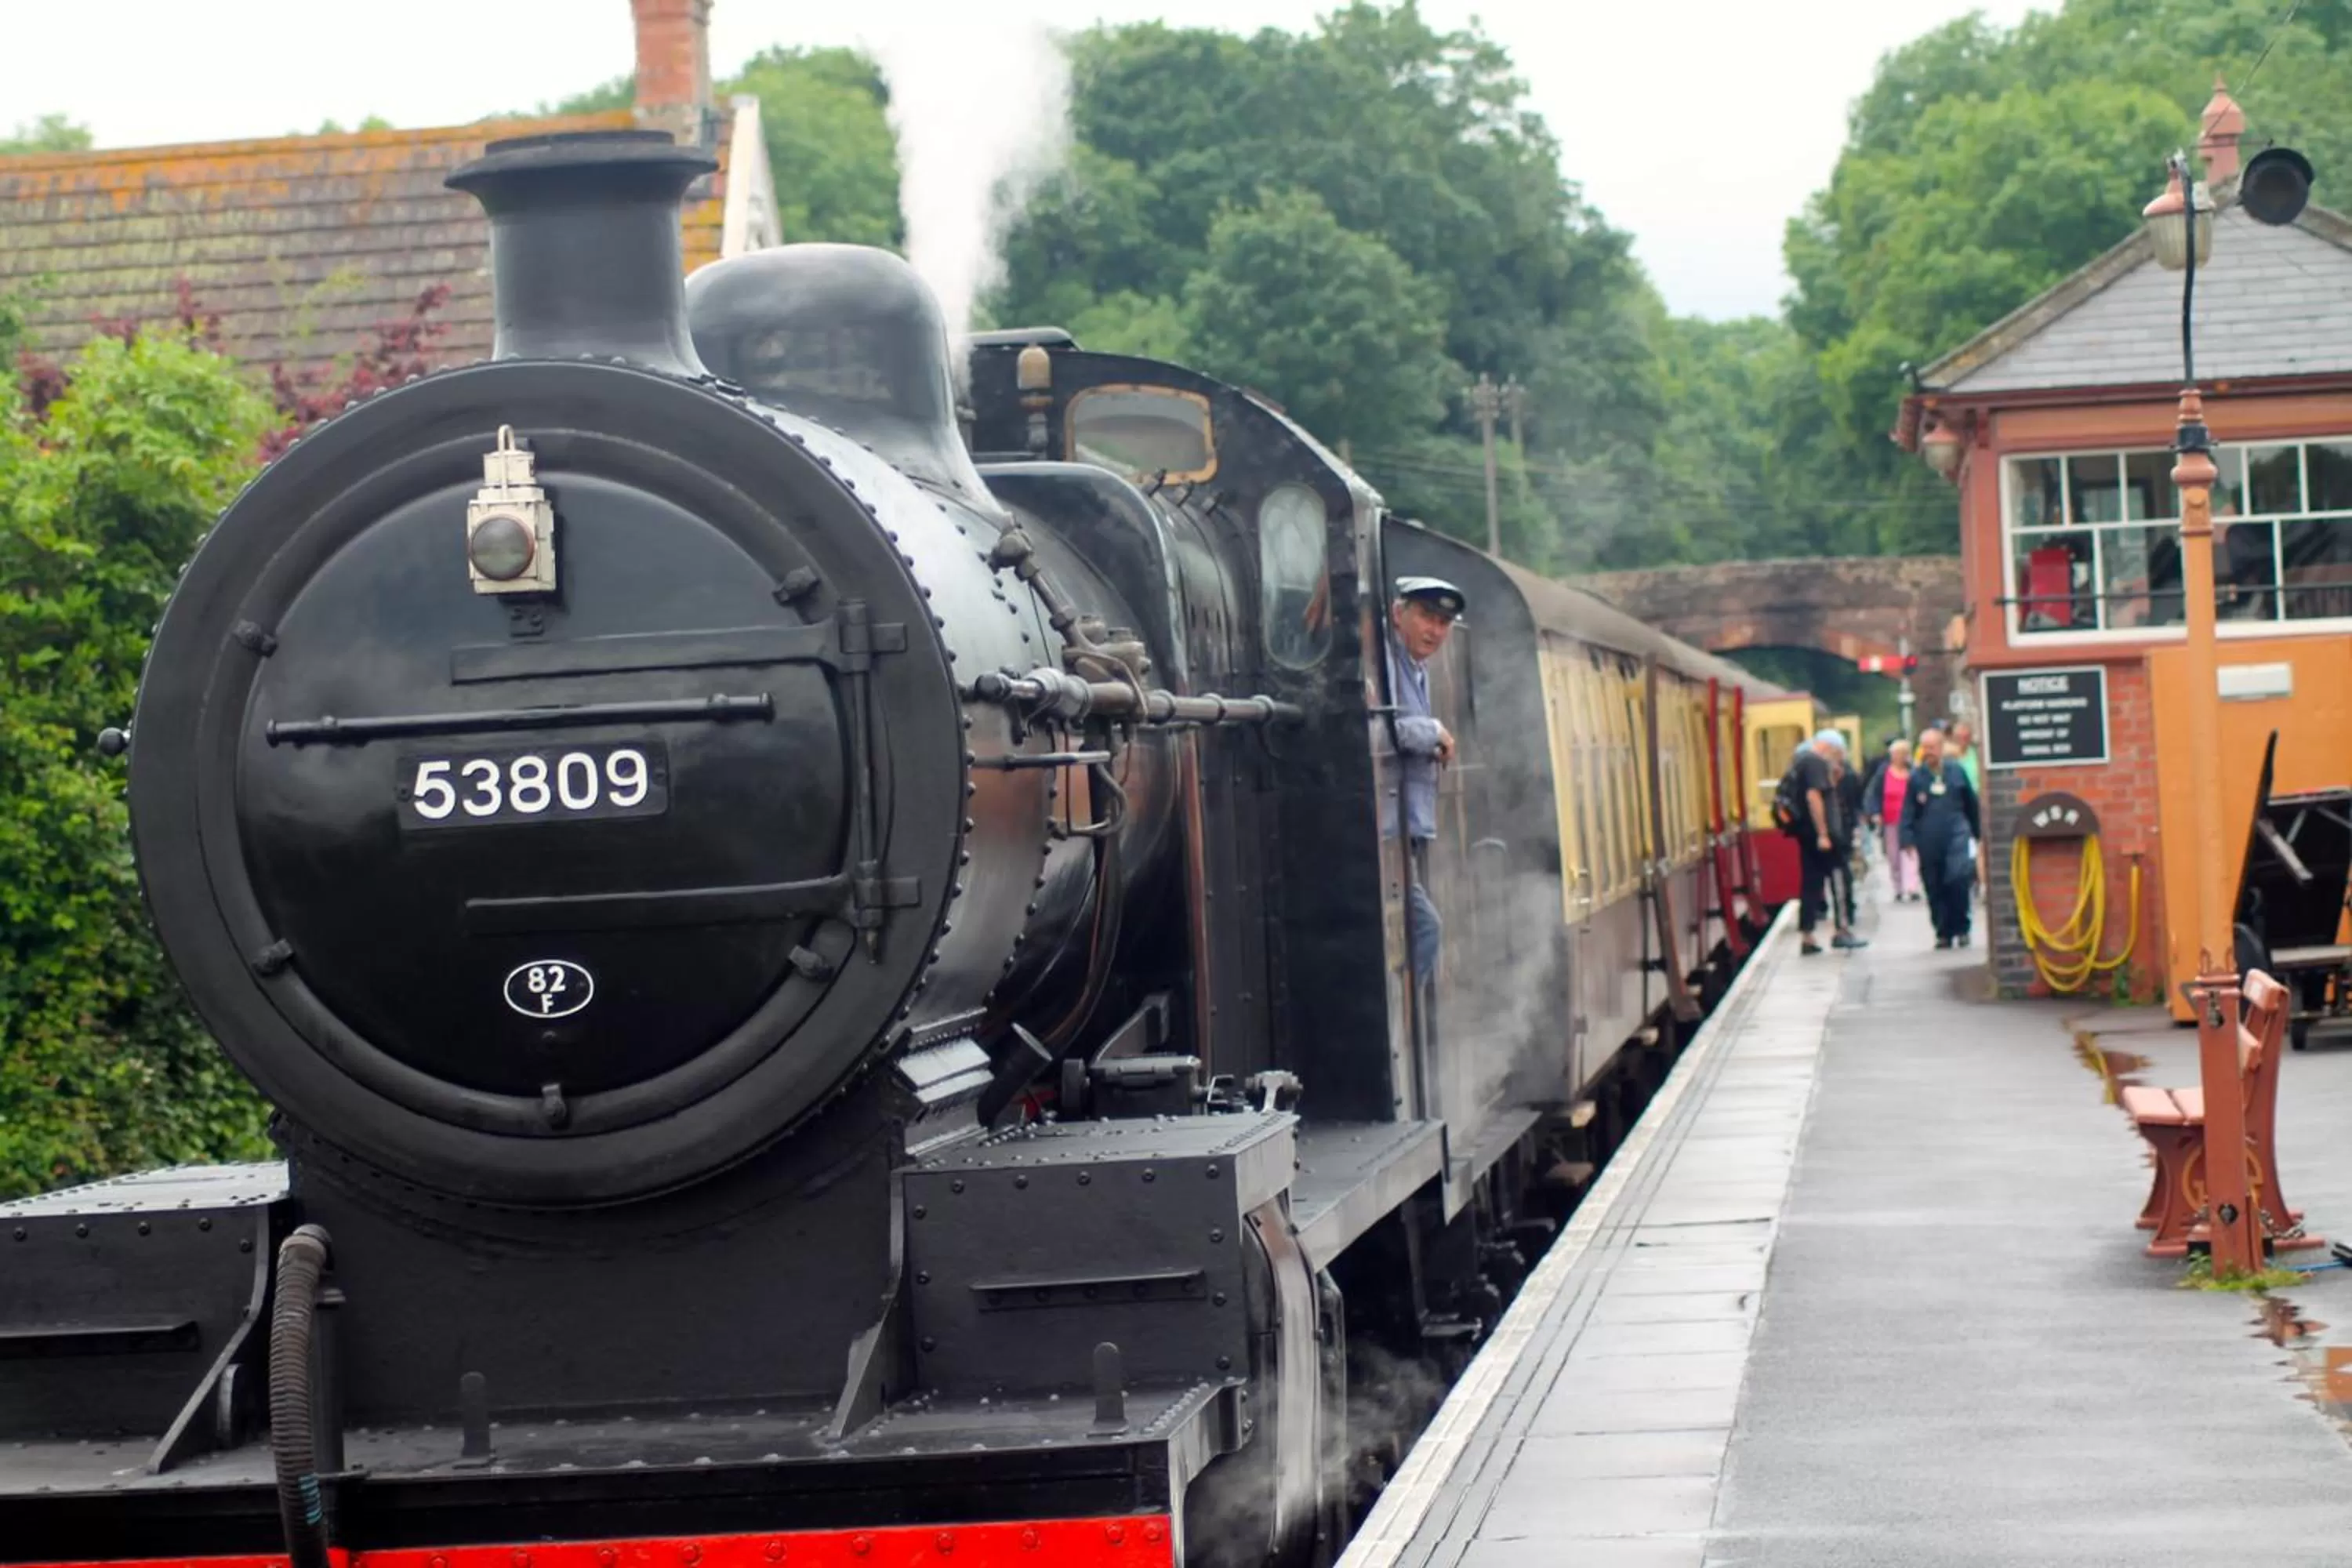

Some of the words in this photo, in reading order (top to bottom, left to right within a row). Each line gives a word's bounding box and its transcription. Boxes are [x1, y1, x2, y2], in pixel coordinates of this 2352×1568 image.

[2017, 676, 2069, 695] NOTICE
[413, 749, 648, 819] 53809
[528, 965, 566, 993] 82
[541, 993, 554, 1014] F
